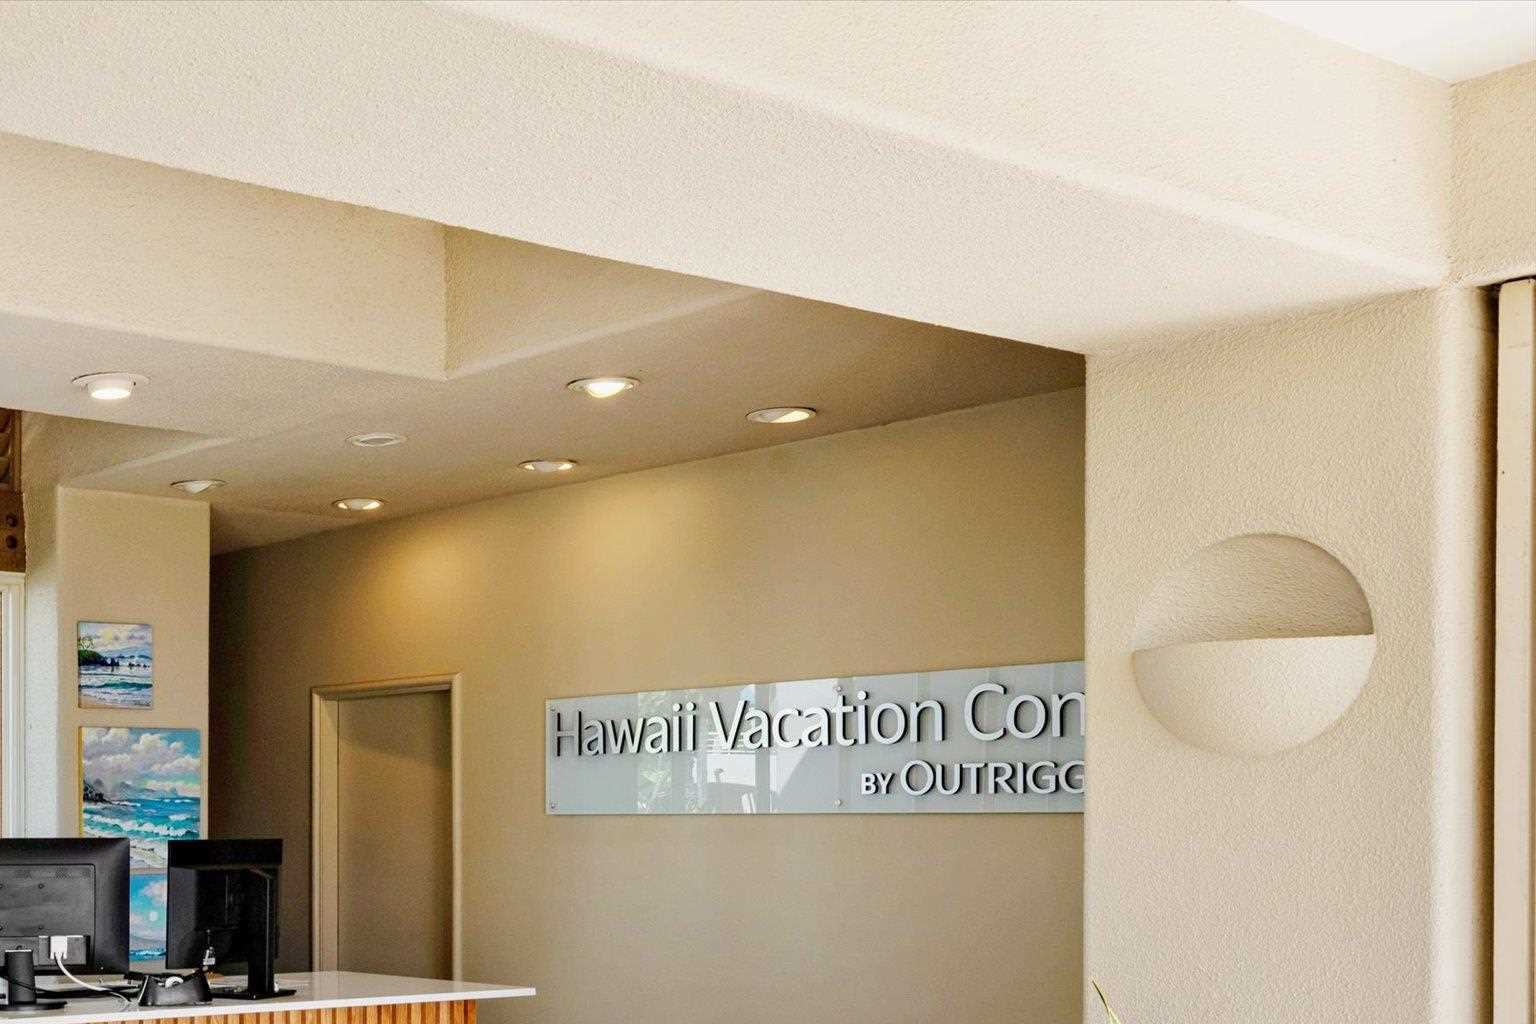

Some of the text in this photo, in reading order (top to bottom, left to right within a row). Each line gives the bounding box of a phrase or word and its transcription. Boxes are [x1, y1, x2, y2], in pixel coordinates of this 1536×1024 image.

[555, 701, 696, 757] Hawaii
[708, 690, 945, 751] Vacation
[860, 771, 895, 796] BY
